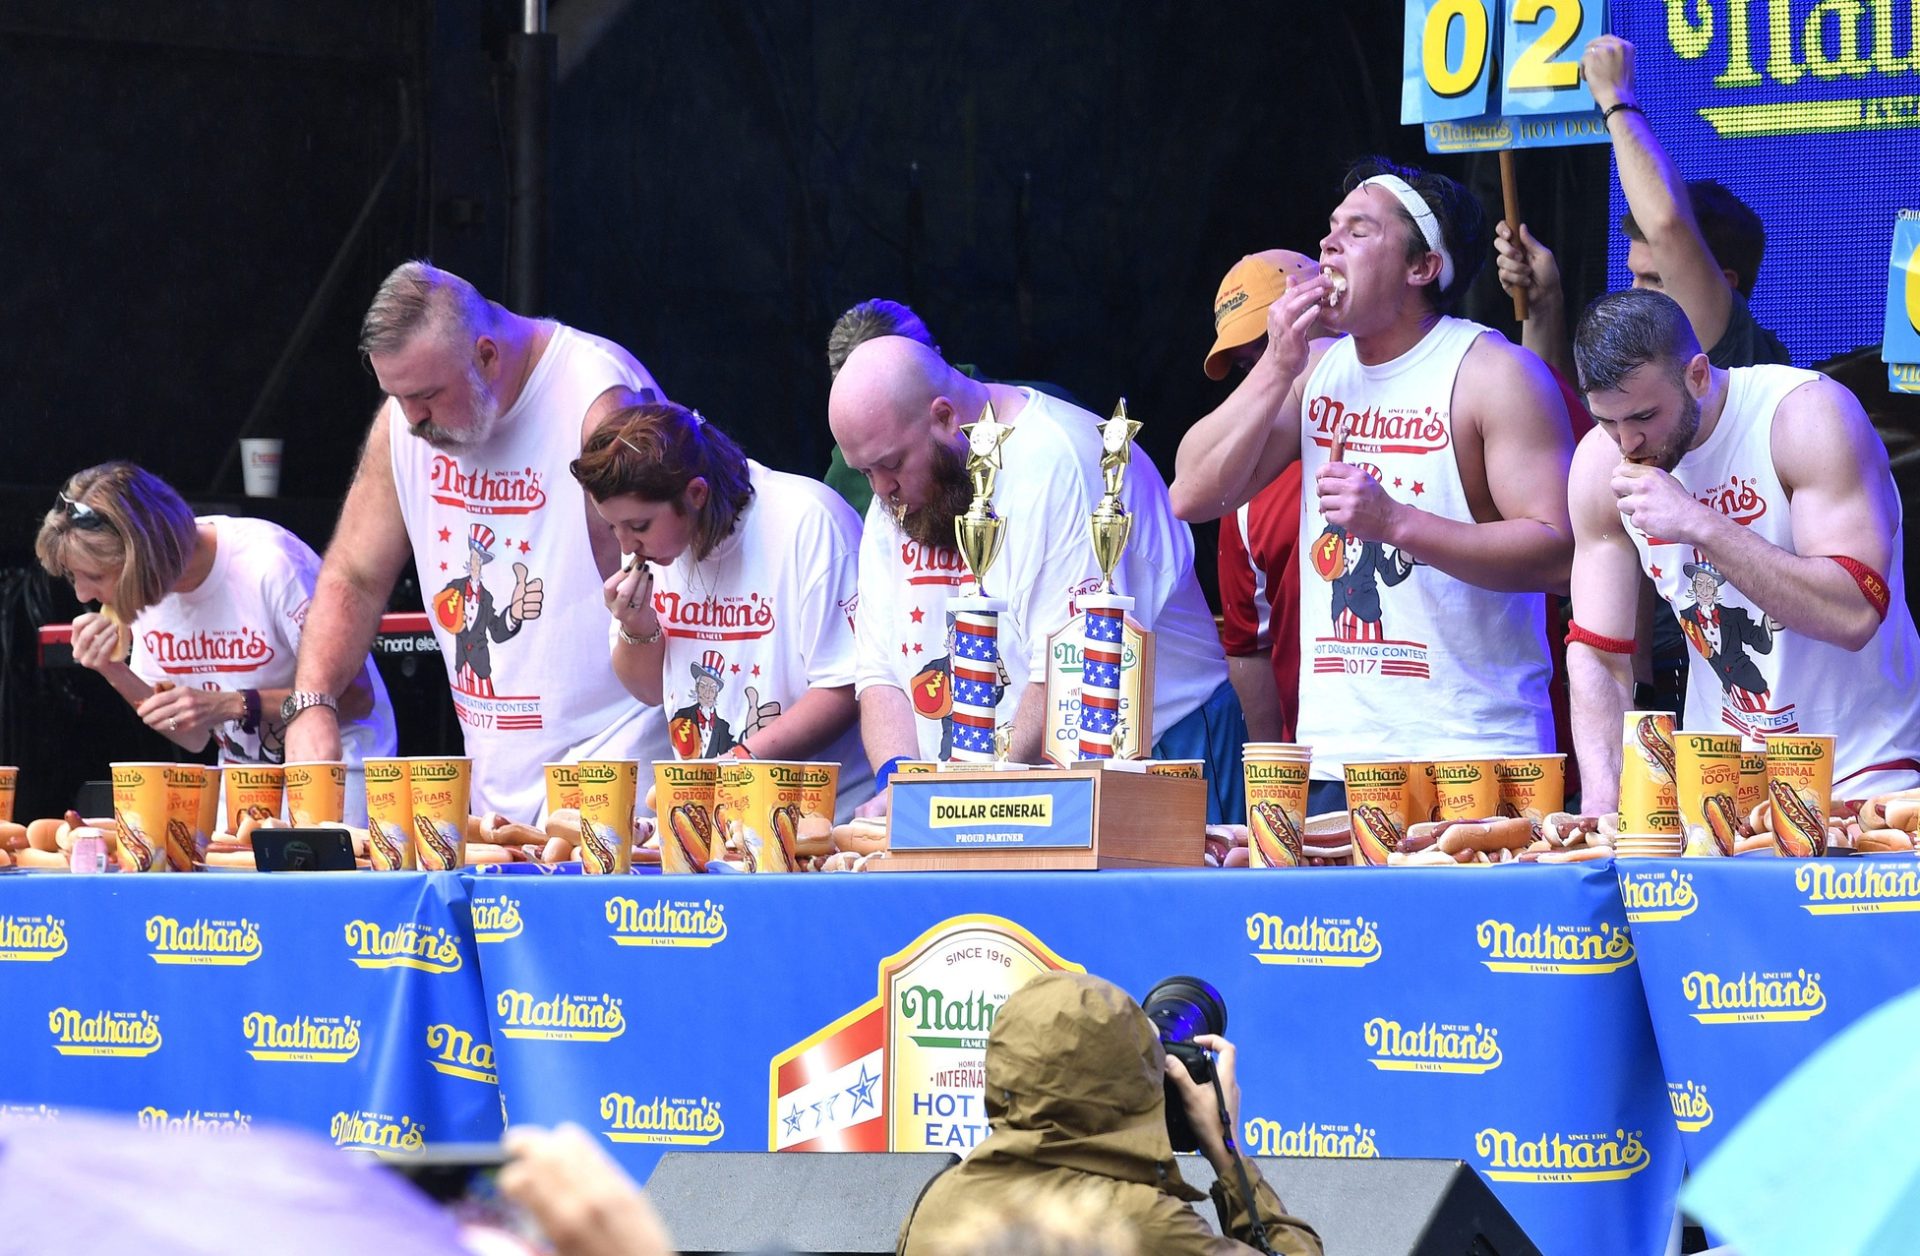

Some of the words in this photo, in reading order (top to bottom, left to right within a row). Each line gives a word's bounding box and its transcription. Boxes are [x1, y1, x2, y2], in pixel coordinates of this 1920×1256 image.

[1422, 0, 1488, 98] 0
[1507, 0, 1584, 93] 2
[1521, 121, 1557, 139] HOT
[1308, 395, 1450, 444] Nathan's
[653, 590, 775, 630] Nathan's
[142, 626, 274, 664] Nathan's
[384, 636, 414, 652] nord
[1382, 647, 1427, 660] CONTEST
[495, 702, 540, 712] CONTEST
[1245, 764, 1307, 781] Nathan's
[1345, 766, 1407, 783] Nathan's
[1767, 766, 1815, 777] RIGINAL
[937, 804, 986, 819] DOLLAR
[990, 802, 1046, 818] GENERAL
[1250, 789, 1301, 799] ORIGINAL
[1350, 792, 1402, 801] ORIGINAL
[956, 834, 985, 843] PROUD
[986, 833, 1024, 843] PARTNER
[605, 896, 727, 934] Nathan's
[1246, 912, 1382, 954] Nathan's
[145, 915, 262, 954] Nathan's
[1476, 919, 1636, 961] Nathan's
[945, 947, 982, 966] SINCE
[986, 949, 1012, 968] 1916
[1682, 968, 1826, 1010] Nathan's
[48, 1007, 162, 1045] Nathan's
[497, 988, 626, 1029] Nathan's
[243, 1012, 361, 1050] Nathan's
[1364, 1017, 1502, 1061] Nathan's
[600, 1092, 724, 1131] Nathan's
[913, 1093, 975, 1117] HOT
[1244, 1117, 1379, 1157] Nathan's
[1475, 1127, 1650, 1170] Nathan's
